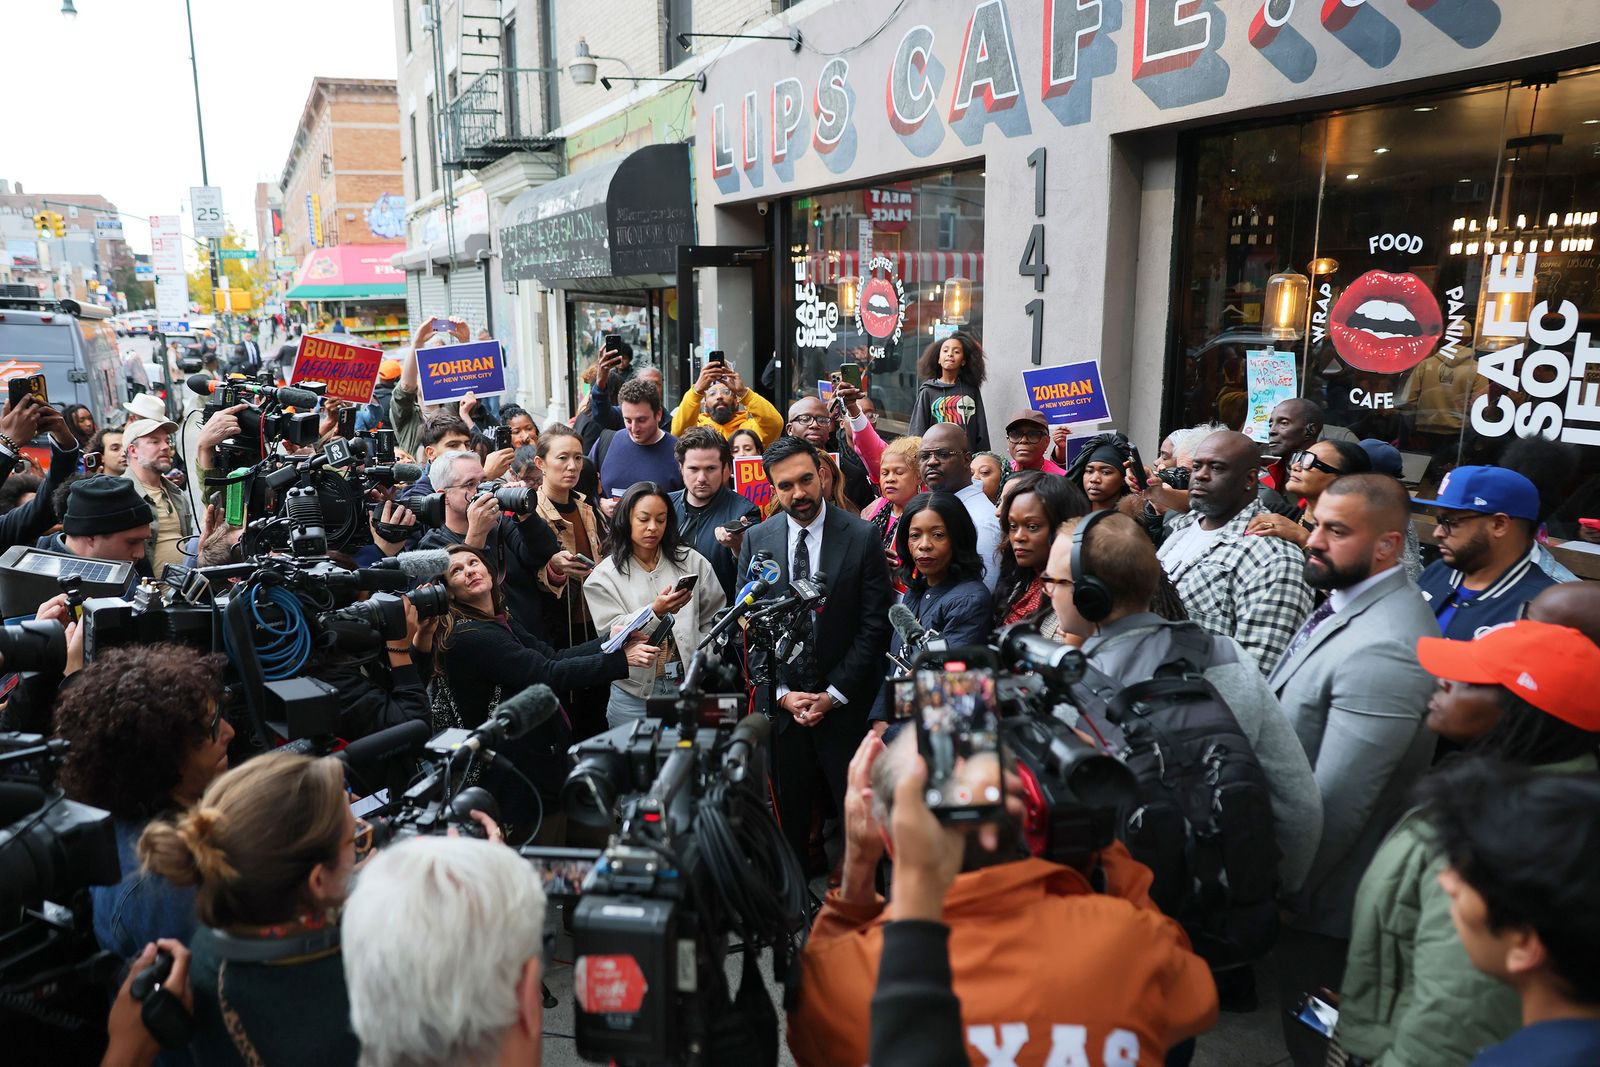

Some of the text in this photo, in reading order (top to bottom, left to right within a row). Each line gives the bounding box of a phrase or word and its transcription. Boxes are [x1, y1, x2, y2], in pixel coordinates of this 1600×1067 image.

[713, 58, 850, 176] LIPS
[197, 207, 220, 221] 25
[1369, 233, 1424, 254] FOOD
[869, 257, 893, 273] COFFEE
[795, 262, 807, 347] CAFE
[805, 282, 817, 348] SOC
[1312, 283, 1333, 344] WRAP
[815, 296, 827, 347] IET
[1439, 285, 1466, 360] PANINI
[303, 339, 356, 360] BUILD
[869, 345, 886, 359] CAFE
[1470, 253, 1538, 437] CAFE
[298, 360, 377, 379] AFFORDABLE
[428, 356, 495, 378] ZOHRAN
[1514, 299, 1579, 441] SOC
[303, 377, 372, 399] USING
[1032, 379, 1094, 401] ZOHRAN
[1350, 387, 1394, 409] CAFE
[1076, 397, 1092, 405] CITY
